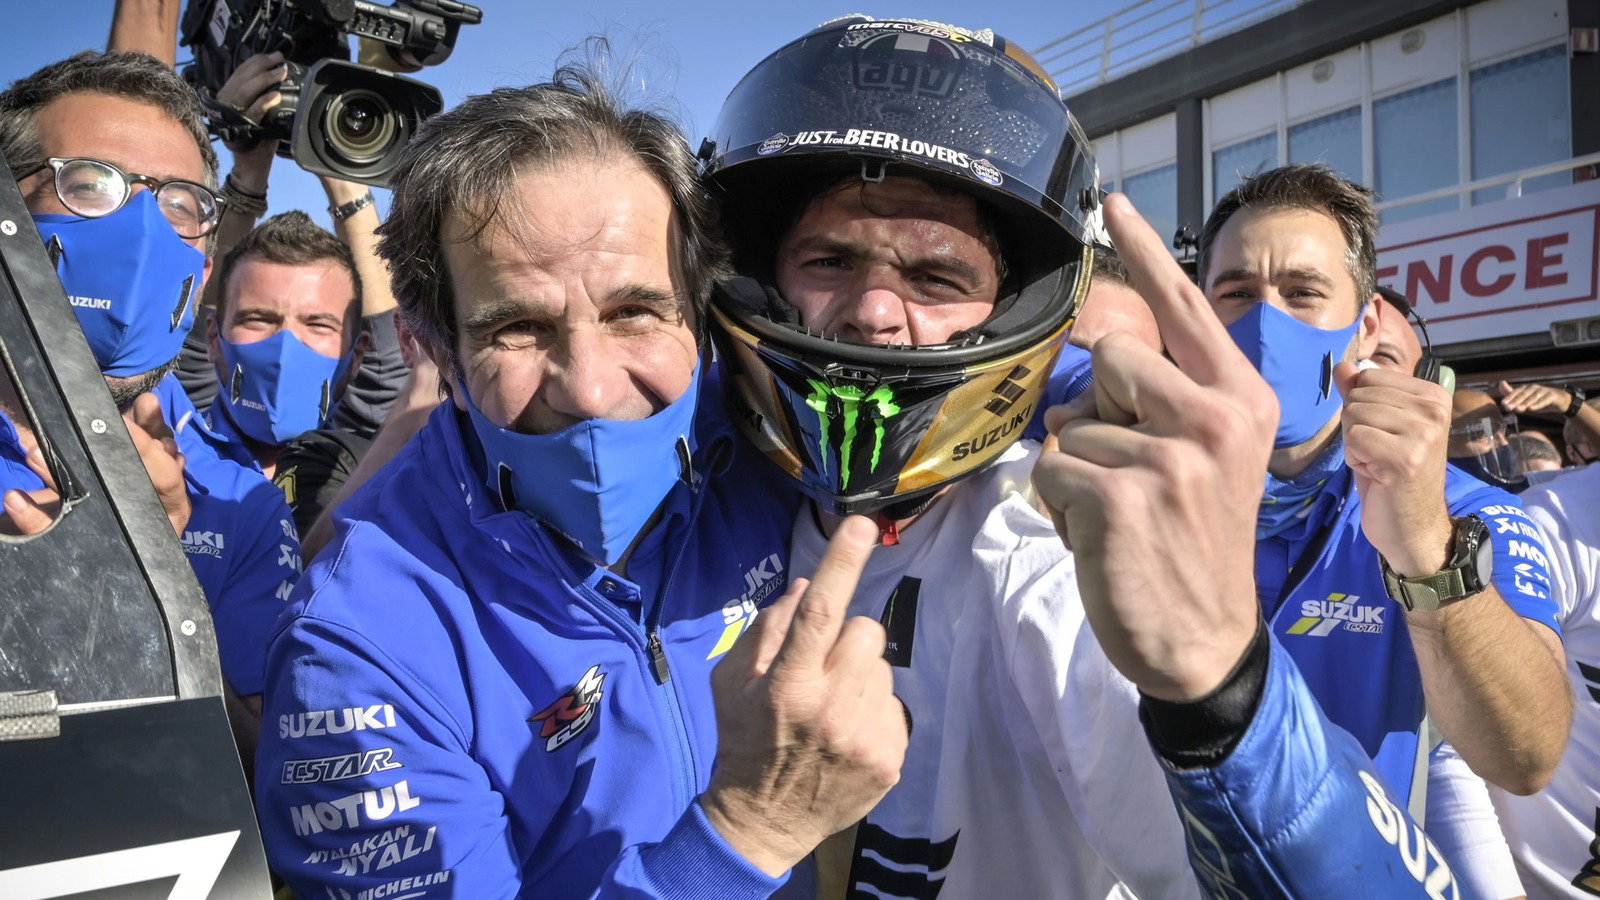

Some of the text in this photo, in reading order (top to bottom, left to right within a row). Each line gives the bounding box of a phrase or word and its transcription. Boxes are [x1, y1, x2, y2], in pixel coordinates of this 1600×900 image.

[788, 130, 838, 146] JUST
[844, 128, 900, 151] BEER
[901, 138, 970, 169] LOVERS
[68, 295, 111, 310] UZUKI
[241, 398, 266, 412] SUZUKI
[952, 402, 1033, 462] SUZUKI
[180, 530, 225, 549] UKI
[1301, 600, 1386, 624] SUZUK
[279, 704, 397, 740] SUZUKI
[281, 747, 404, 784] ECSTAR
[290, 780, 421, 837] MOTUL
[303, 825, 410, 864] NYALAKAN
[332, 826, 437, 876] NYALI
[1358, 769, 1460, 900] SUZ
[357, 869, 450, 900] MICHELIN
